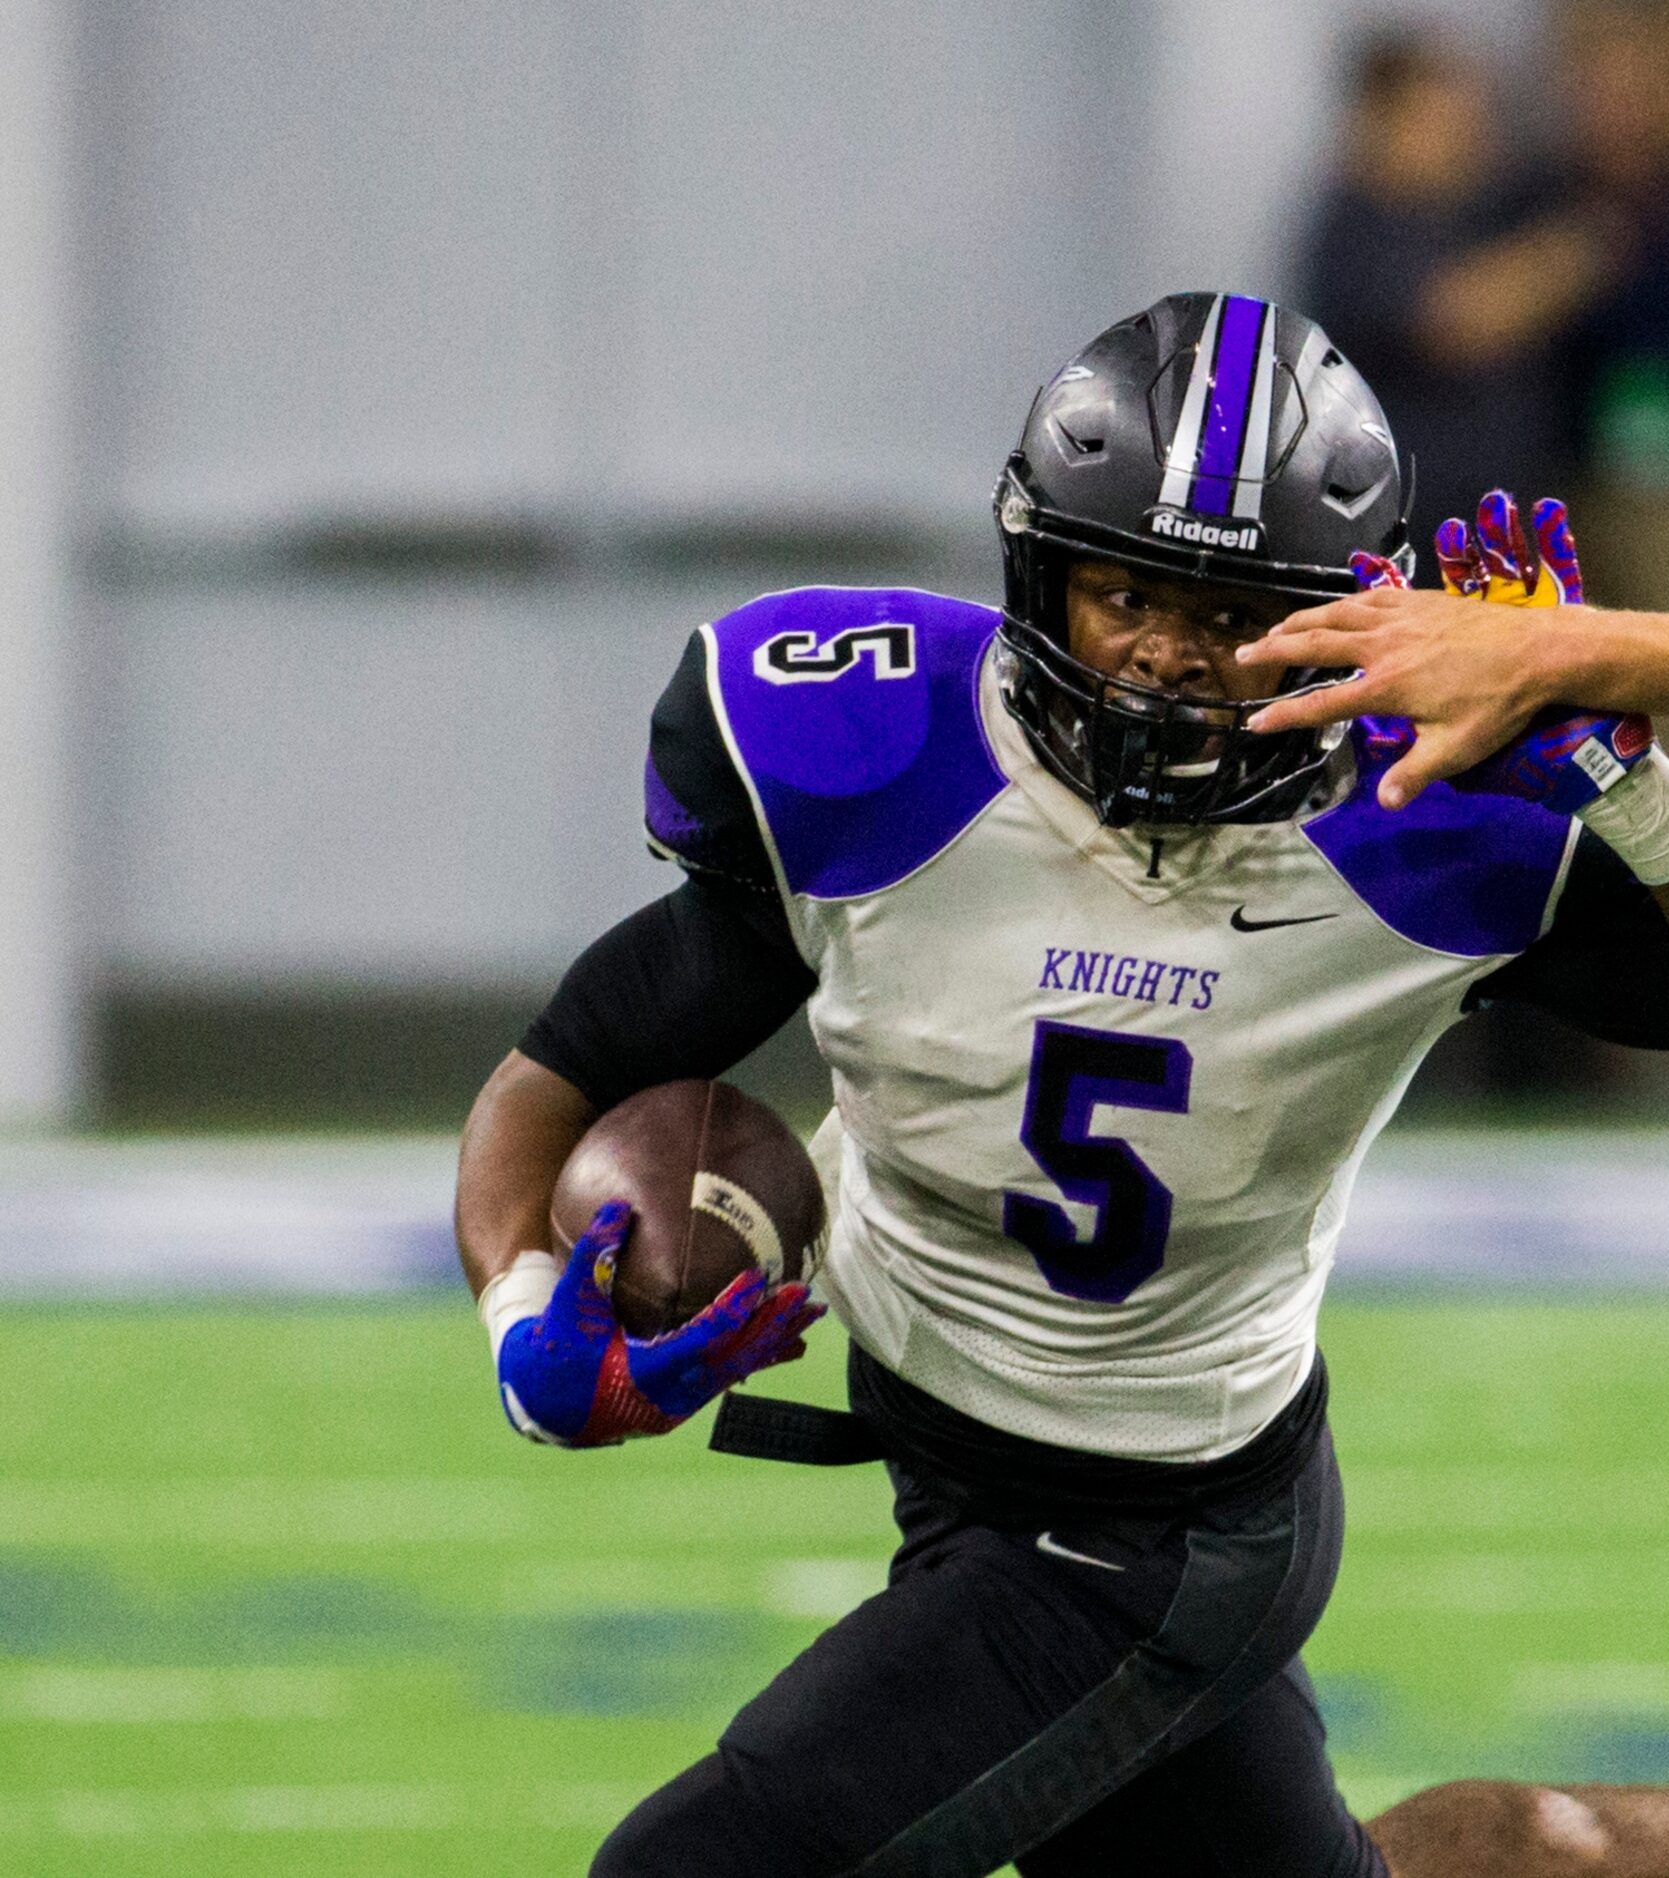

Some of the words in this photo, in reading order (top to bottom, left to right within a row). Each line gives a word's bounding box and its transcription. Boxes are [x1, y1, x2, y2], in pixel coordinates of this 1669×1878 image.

[753, 622, 915, 686] 5
[1039, 947, 1219, 1010] KNIGHTS
[1002, 1018, 1193, 1304] 5
